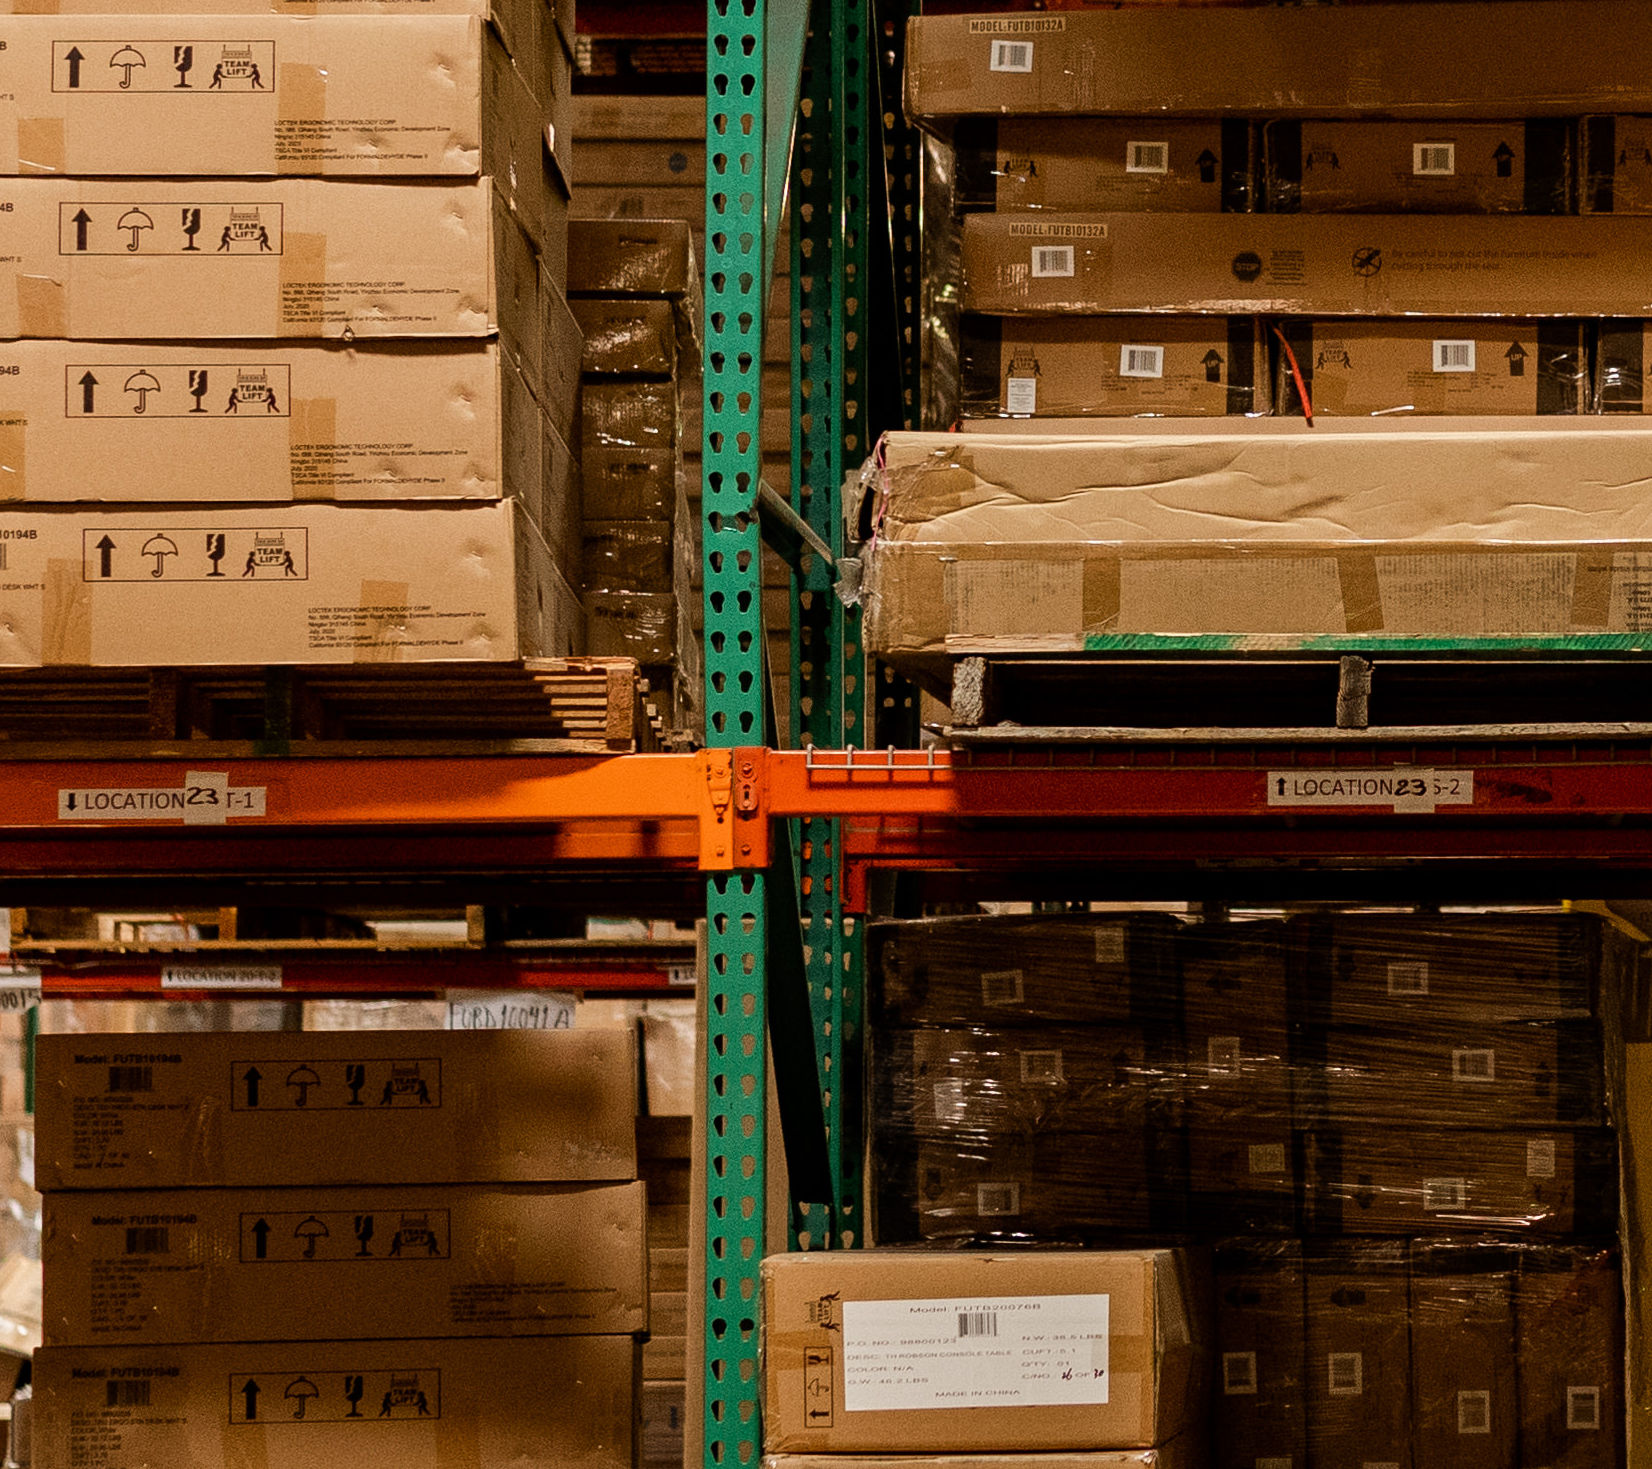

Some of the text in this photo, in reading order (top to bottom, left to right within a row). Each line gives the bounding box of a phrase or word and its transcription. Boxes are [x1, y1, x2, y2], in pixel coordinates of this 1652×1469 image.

[1294, 778, 1460, 796] LOCATION 23 S-2
[85, 787, 254, 811] LOCATION 23 T-1
